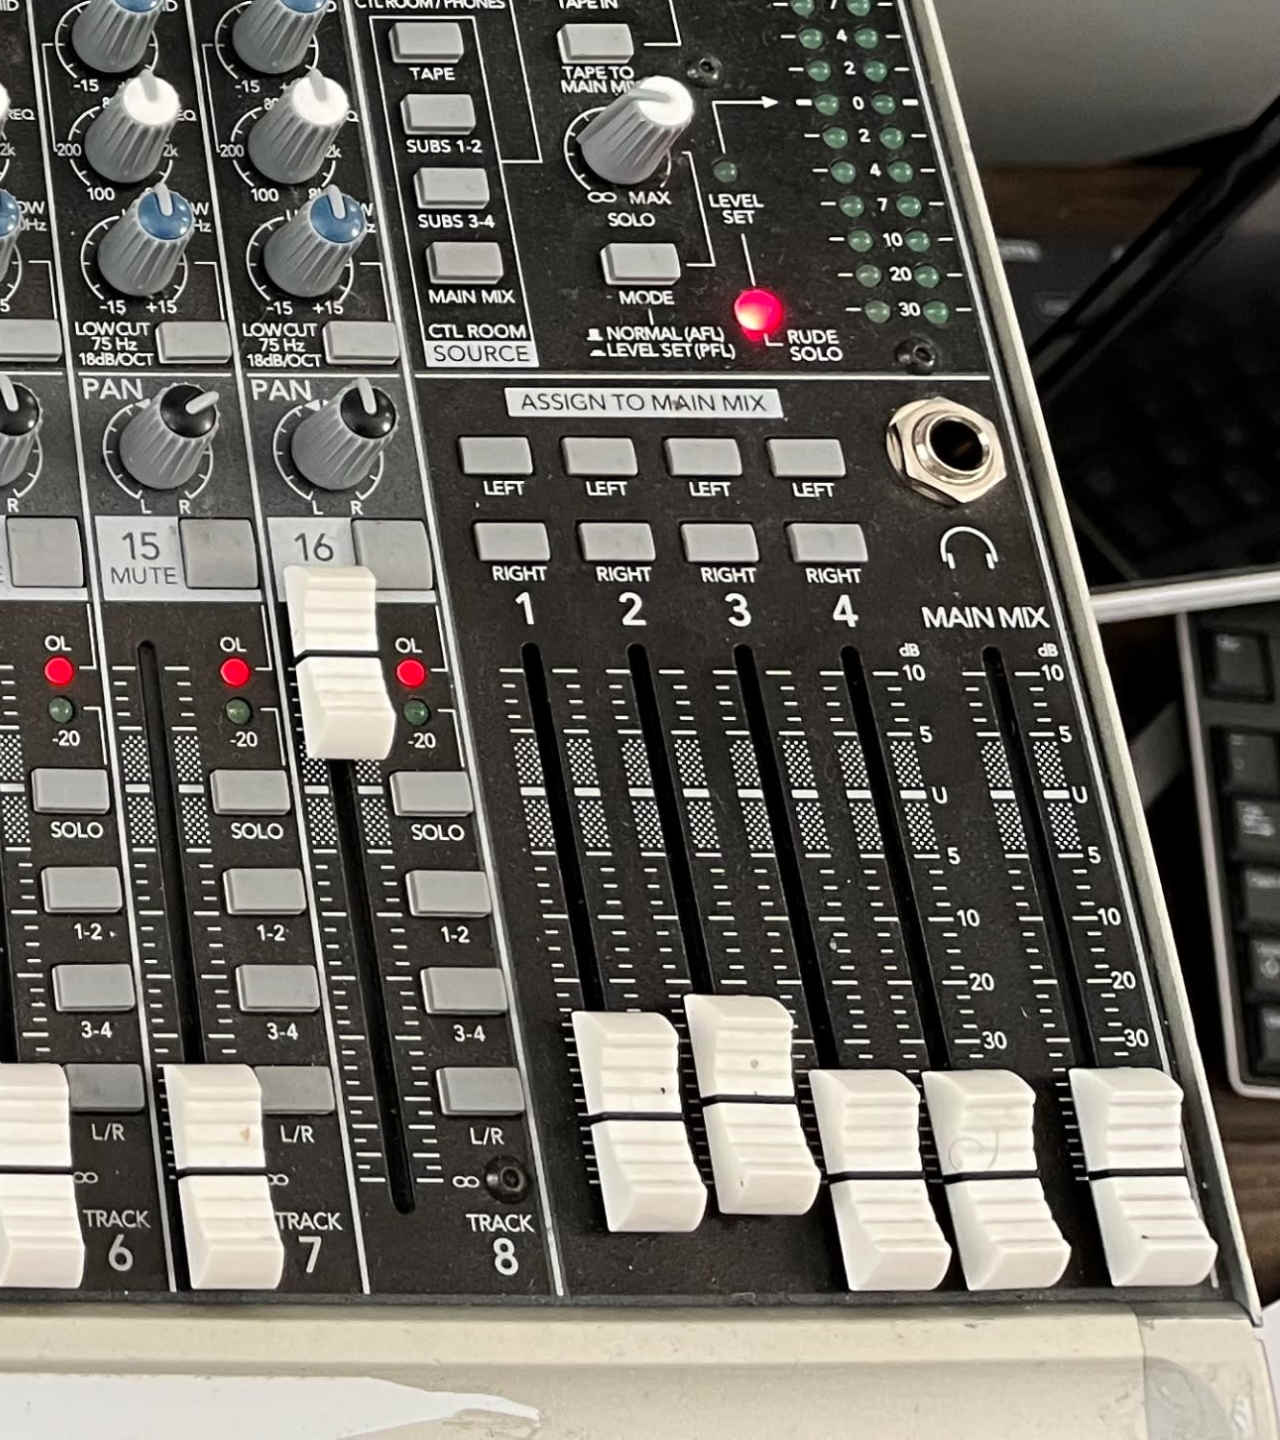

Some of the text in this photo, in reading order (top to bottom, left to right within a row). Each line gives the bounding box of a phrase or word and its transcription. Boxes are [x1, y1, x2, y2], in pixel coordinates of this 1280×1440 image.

[409, 68, 455, 80] TAPE
[561, 66, 634, 79] TAPE TO
[561, 80, 607, 92] MAIN
[407, 140, 482, 153] SUBS 1-2
[629, 192, 671, 204] MAX
[709, 194, 764, 207] LEVEL
[418, 214, 495, 228] SUBS 3-4
[608, 213, 655, 226] SOLO
[723, 210, 754, 224] SET
[429, 290, 515, 303] MAIN MIX
[619, 291, 674, 304] MODE
[899, 302, 920, 316] 30
[429, 324, 526, 339] CTL ROOM
[607, 327, 682, 340] NORMAL
[787, 330, 839, 344] RUDE
[434, 345, 529, 361] SOURCE
[607, 343, 658, 357] LEVEL
[790, 346, 843, 361] SOLO
[522, 393, 766, 411] ASSIGN TO MAIN MIX
[484, 481, 524, 495] LEFT
[586, 481, 627, 495] LEFT
[690, 482, 730, 496] LEFT
[793, 483, 834, 497] LEFT
[295, 533, 333, 561] 16
[493, 566, 547, 581] RIGHT
[596, 567, 651, 581] RIGHT
[701, 567, 756, 582] RIGHT
[806, 568, 861, 583] RIGHT
[516, 592, 534, 624] 1
[619, 592, 646, 625] 2
[725, 593, 751, 626] 3
[833, 595, 858, 627] 4
[922, 607, 1050, 628] MAIN MIX
[466, 1214, 534, 1232] TRACK
[494, 1238, 518, 1275] 8
